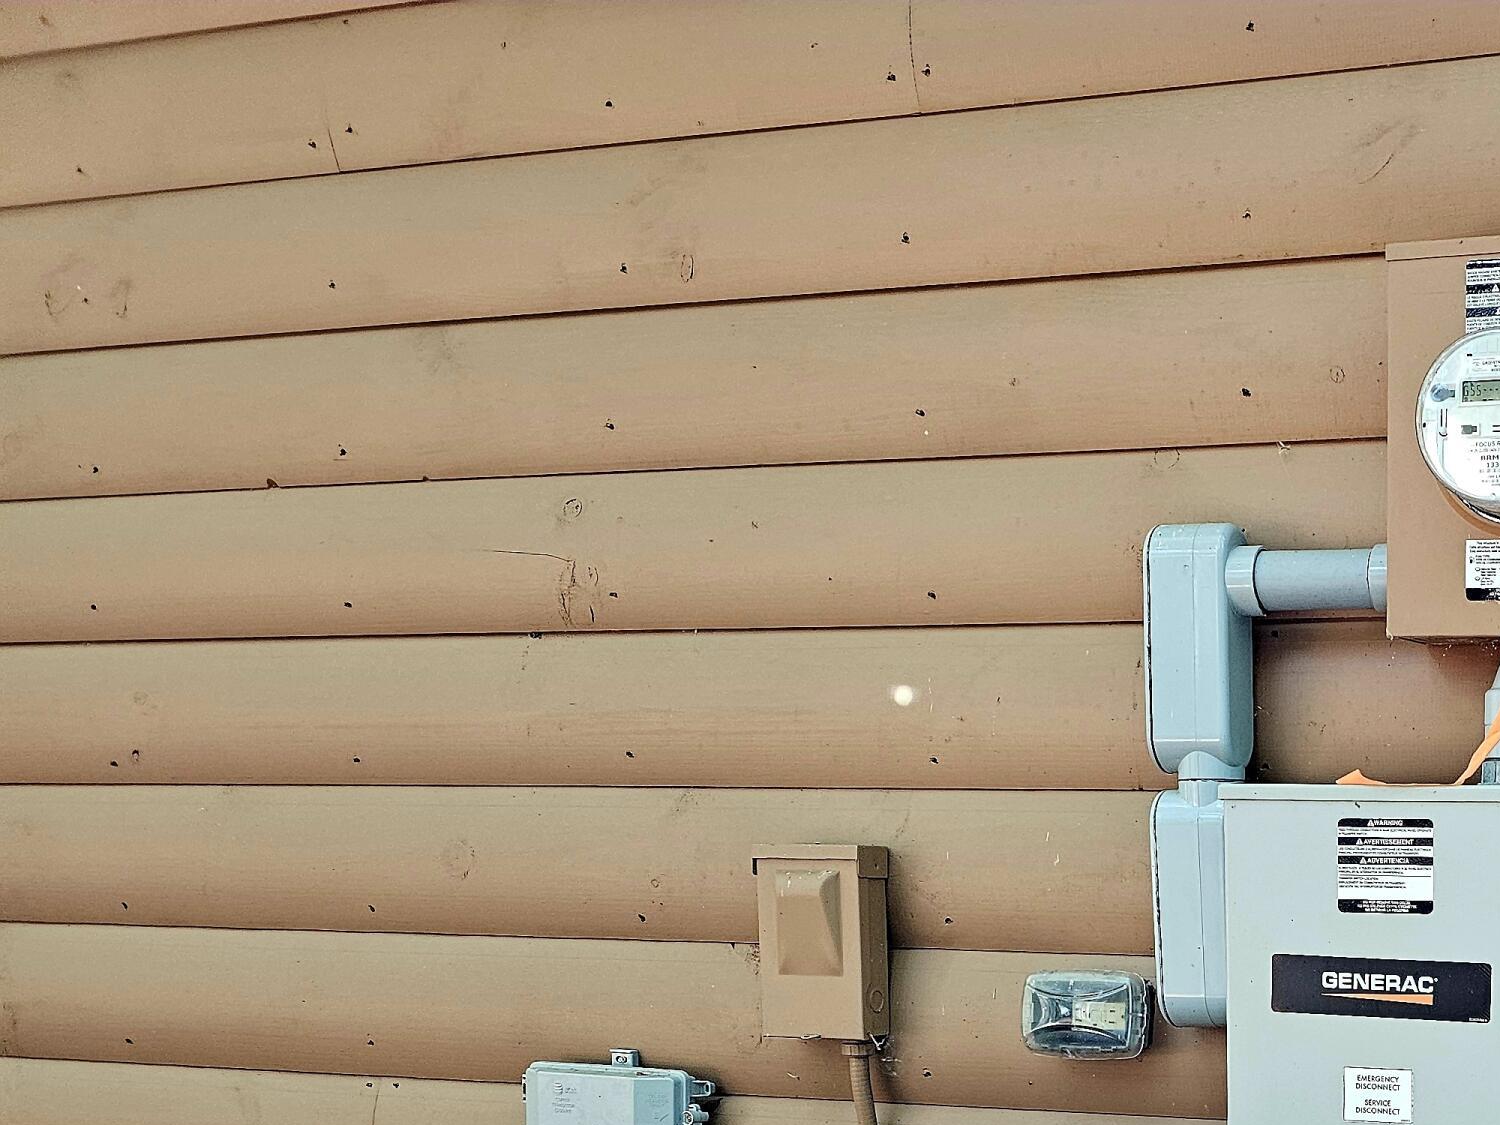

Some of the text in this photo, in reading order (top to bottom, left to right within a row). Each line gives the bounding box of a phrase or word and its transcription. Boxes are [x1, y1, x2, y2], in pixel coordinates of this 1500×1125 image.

[1373, 819, 1404, 827] WARNING
[1363, 838, 1415, 846] AVERTISSEMENT
[1367, 857, 1410, 865] ADVERTENCIA
[1321, 971, 1434, 994] GENERAC
[1356, 1074, 1400, 1083] EMERGENCY
[1355, 1082, 1401, 1091] DISCONNECT
[1364, 1098, 1391, 1107] SERVICE
[1355, 1106, 1401, 1115] DISCONNECT
